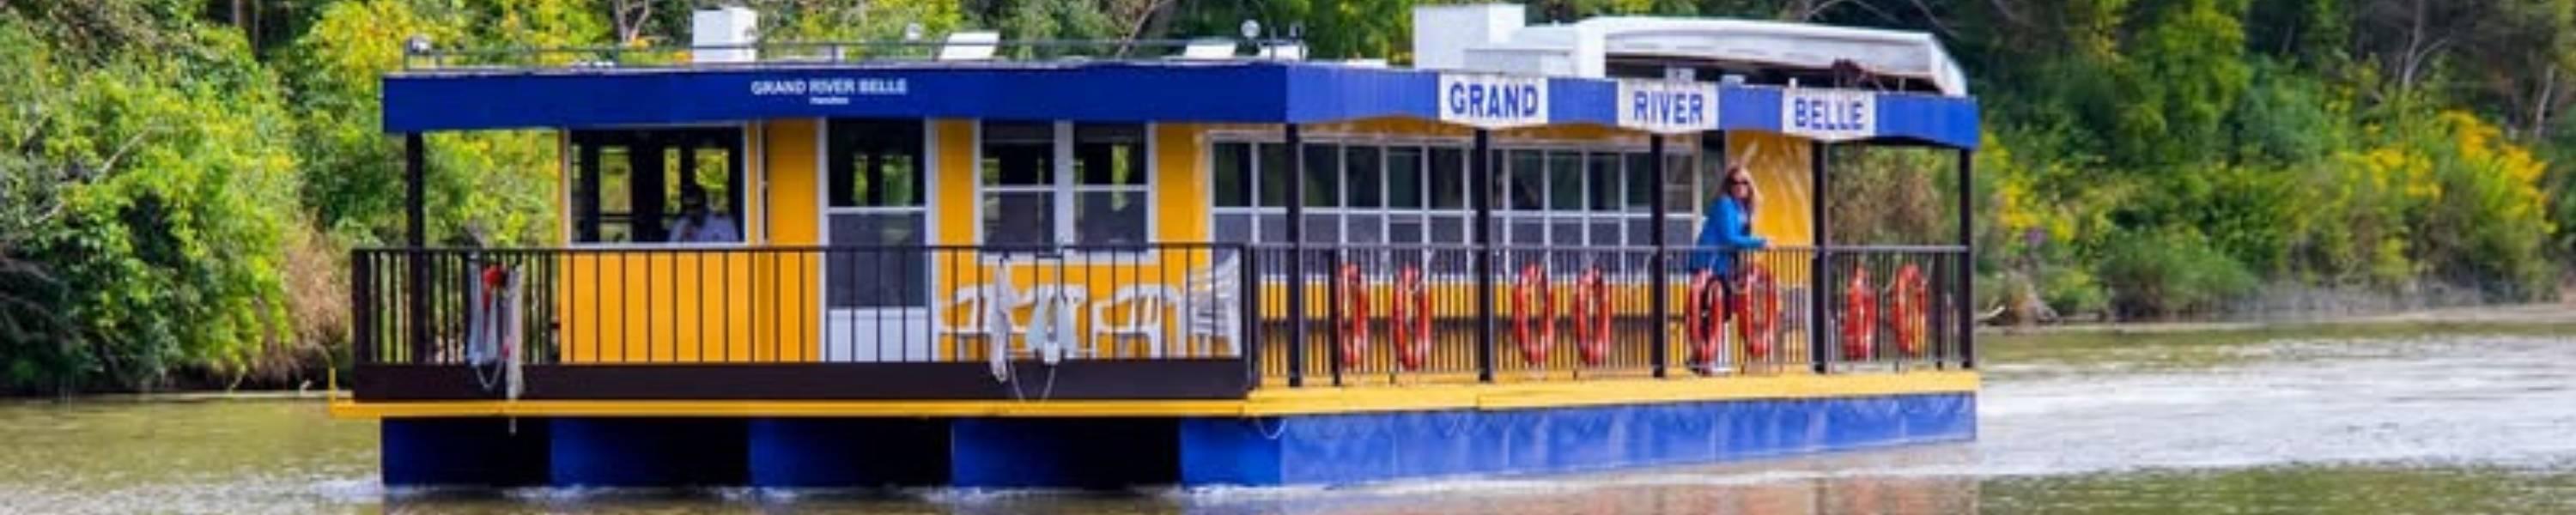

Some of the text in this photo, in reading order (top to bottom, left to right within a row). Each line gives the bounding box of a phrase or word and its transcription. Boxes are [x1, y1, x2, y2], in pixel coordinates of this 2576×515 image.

[750, 78, 908, 95] GRAND RIVER BELLE
[1449, 82, 1864, 131] GRAND RIVER BELLE
